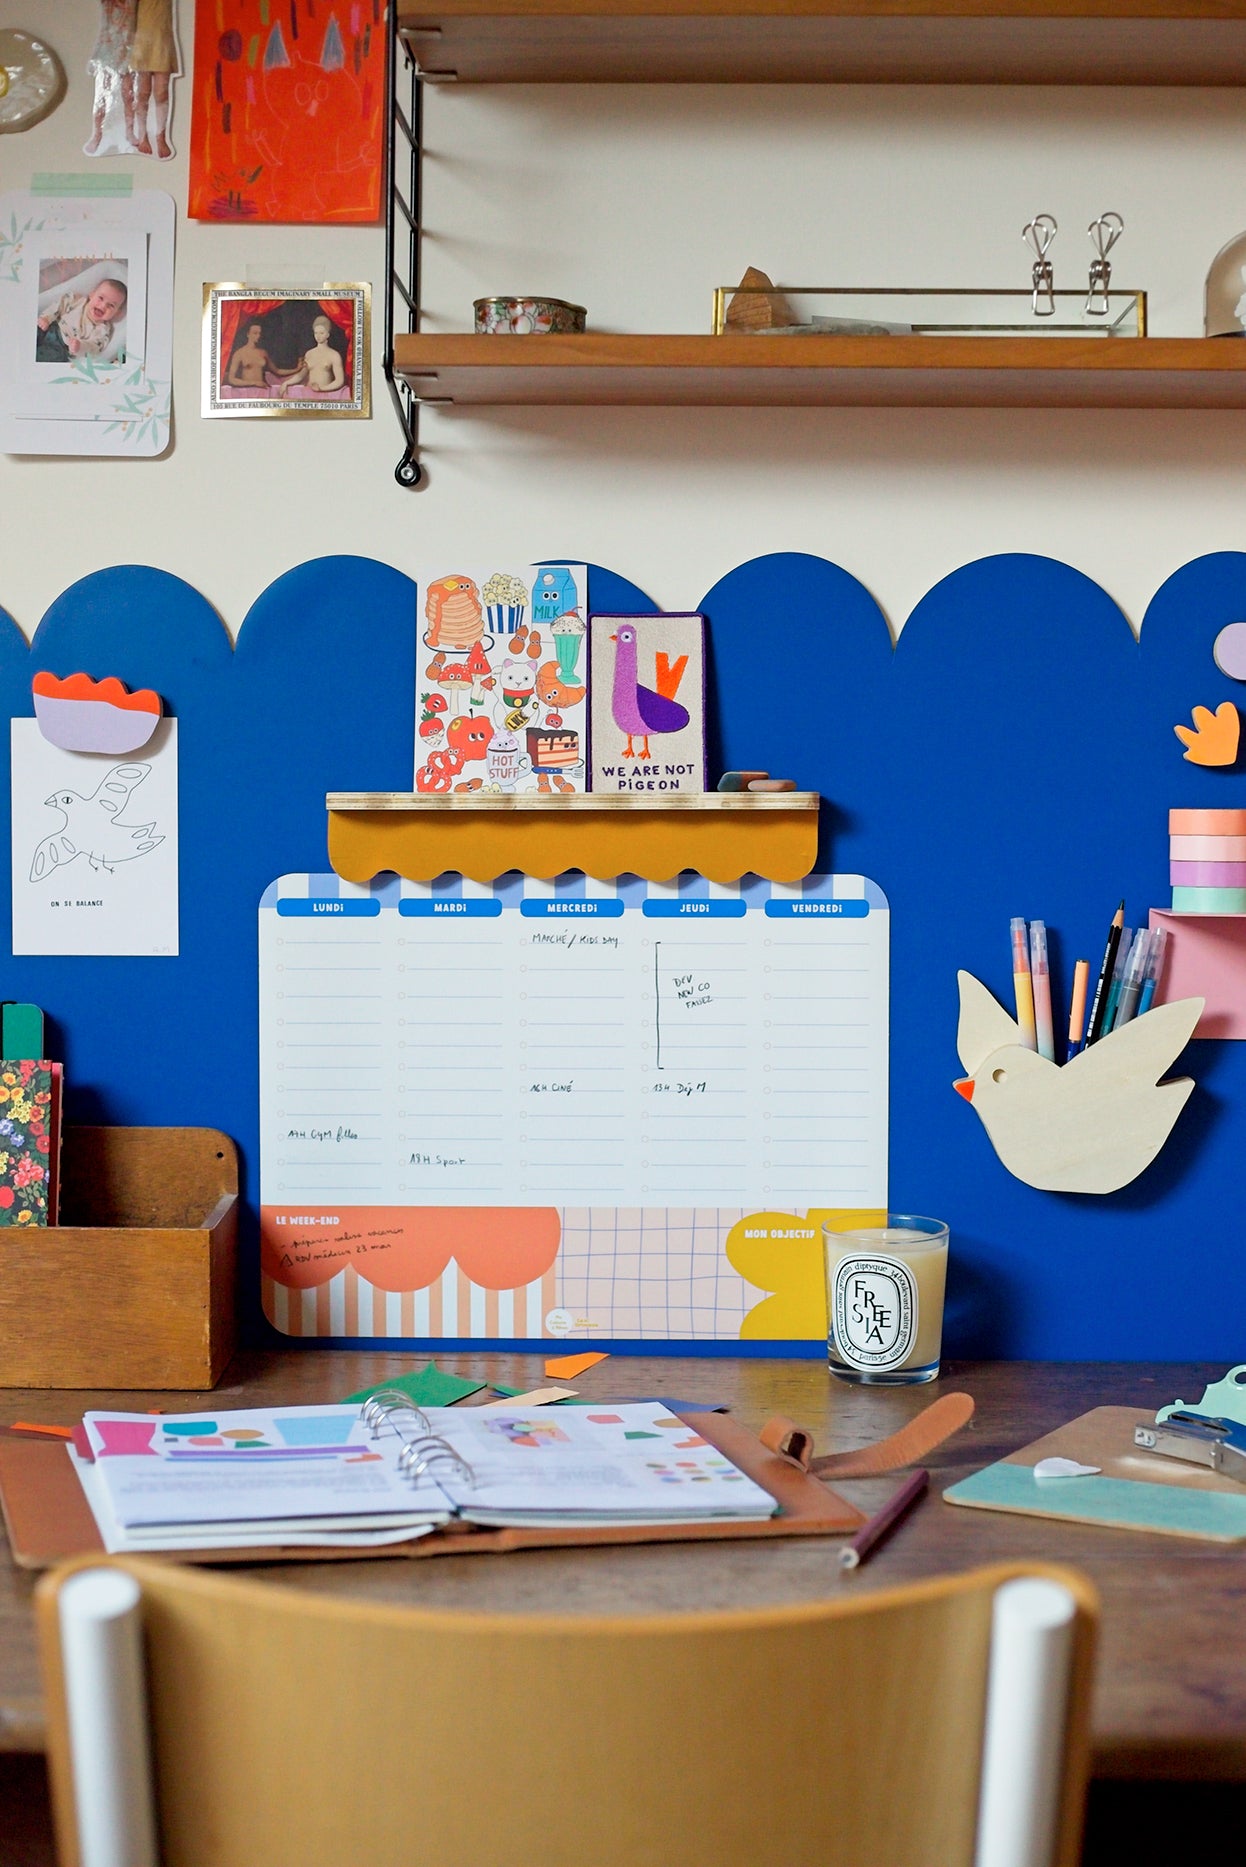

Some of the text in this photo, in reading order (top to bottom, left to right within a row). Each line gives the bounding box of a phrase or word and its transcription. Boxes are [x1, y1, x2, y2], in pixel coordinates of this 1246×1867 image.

[533, 605, 559, 619] MILK
[507, 710, 529, 730] LUCK
[492, 755, 514, 766] HOT
[490, 768, 519, 779] STUFF
[602, 763, 695, 778] WE ARE NOT
[697, 982, 711, 992] CO
[276, 1216, 340, 1225] LE WEEK-END
[744, 1229, 768, 1238] MON
[854, 1262, 888, 1272] diptyque
[897, 1274, 910, 1310] boulevard
[889, 1330, 908, 1358] germain
